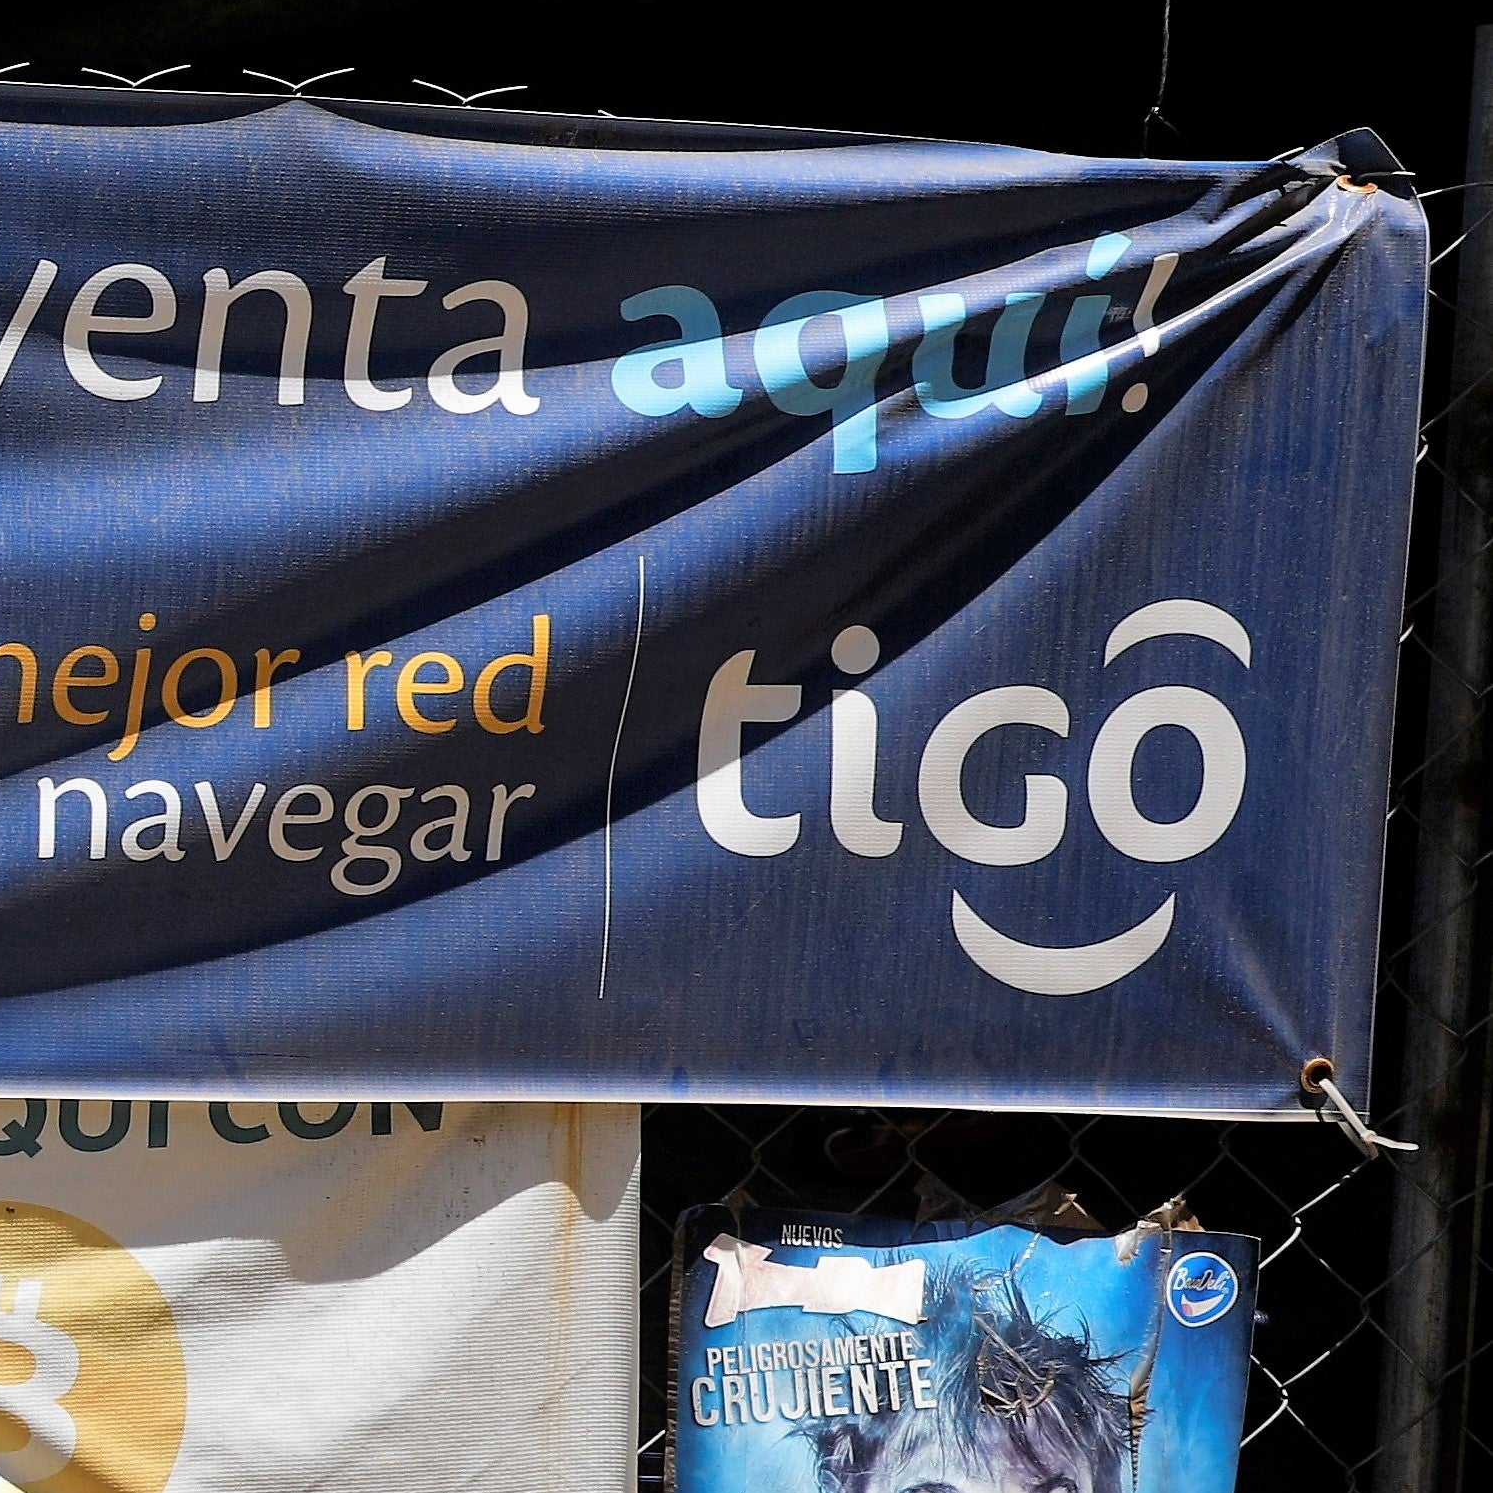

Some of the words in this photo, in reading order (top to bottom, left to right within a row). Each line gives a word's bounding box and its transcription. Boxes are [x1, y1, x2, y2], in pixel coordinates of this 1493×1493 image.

[610, 231, 1180, 476] aquí!
[346, 613, 552, 736] red
[37, 772, 537, 899] navegar
[781, 1224, 844, 1249] NUEVOS
[691, 1359, 939, 1427] CRUJIENTE
[706, 1331, 918, 1376] PELIGROSAMENTE
